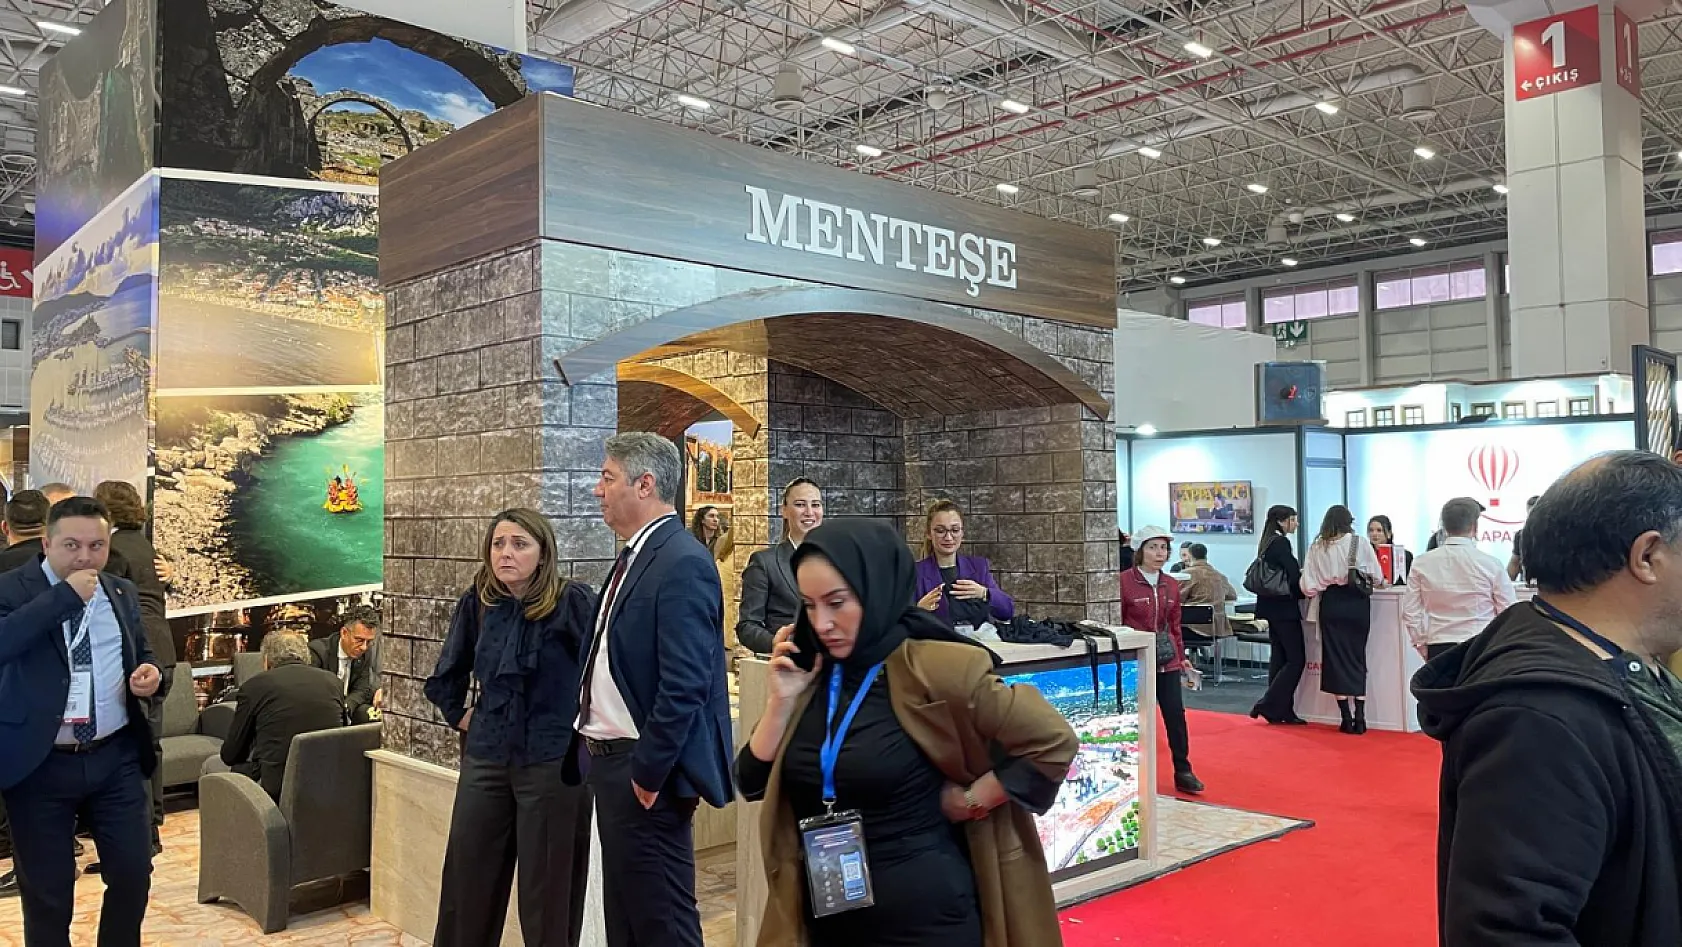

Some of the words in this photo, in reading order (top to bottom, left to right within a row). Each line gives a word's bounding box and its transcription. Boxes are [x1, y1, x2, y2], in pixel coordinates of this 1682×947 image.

[1541, 20, 1567, 69] 1
[1535, 68, 1579, 91] ÇIKIŞ
[745, 184, 1018, 298] MENTEŞE
